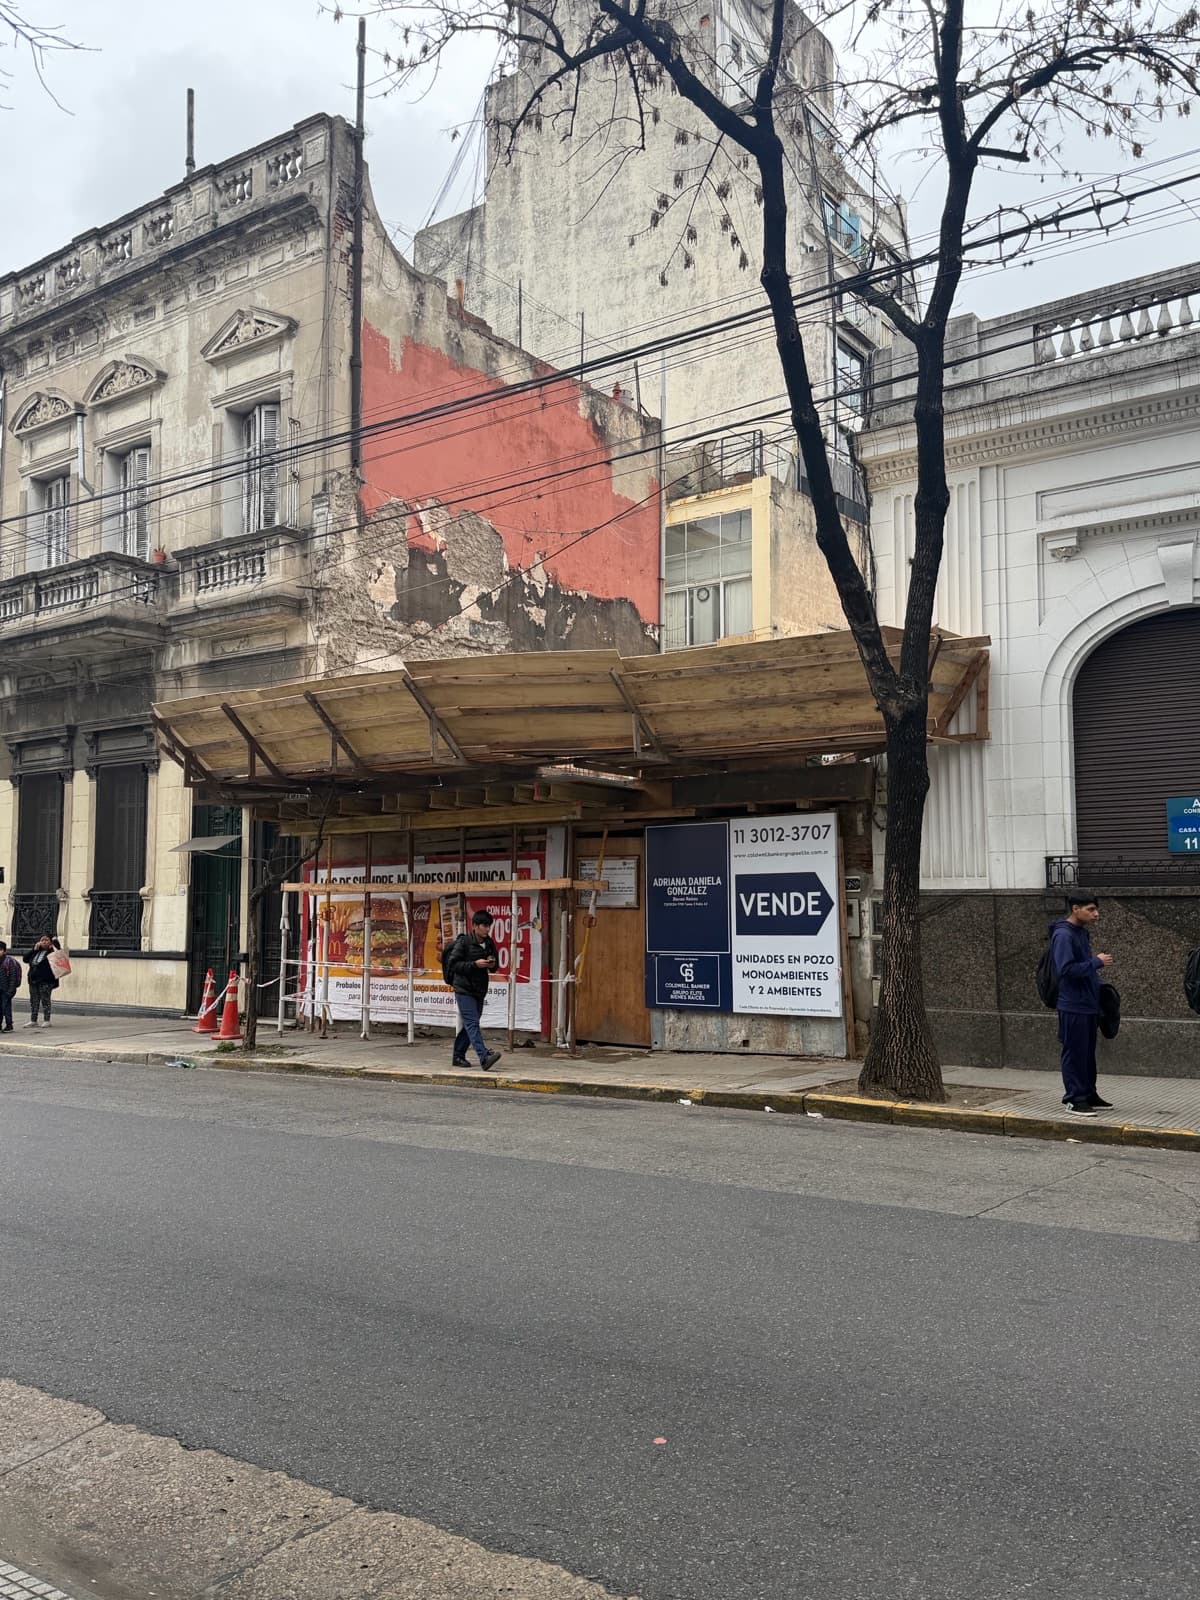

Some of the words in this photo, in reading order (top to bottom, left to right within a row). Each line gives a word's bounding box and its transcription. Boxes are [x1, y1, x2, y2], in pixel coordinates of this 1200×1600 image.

[734, 829, 745, 844] 11
[750, 824, 831, 843] 3012-3707
[653, 877, 687, 887] ADRIANA
[688, 876, 722, 886] DANIELA
[666, 886, 707, 896] GONZALEZ
[739, 891, 822, 917] VENDE
[486, 905, 500, 916] CON
[736, 954, 785, 964] UNIDADES
[788, 955, 801, 964] EN
[804, 955, 835, 965] POZO
[742, 970, 829, 981] MONOAMBIENTES
[749, 985, 756, 995] Y
[758, 986, 764, 995] 2
[767, 986, 822, 997] AMBIENTES
